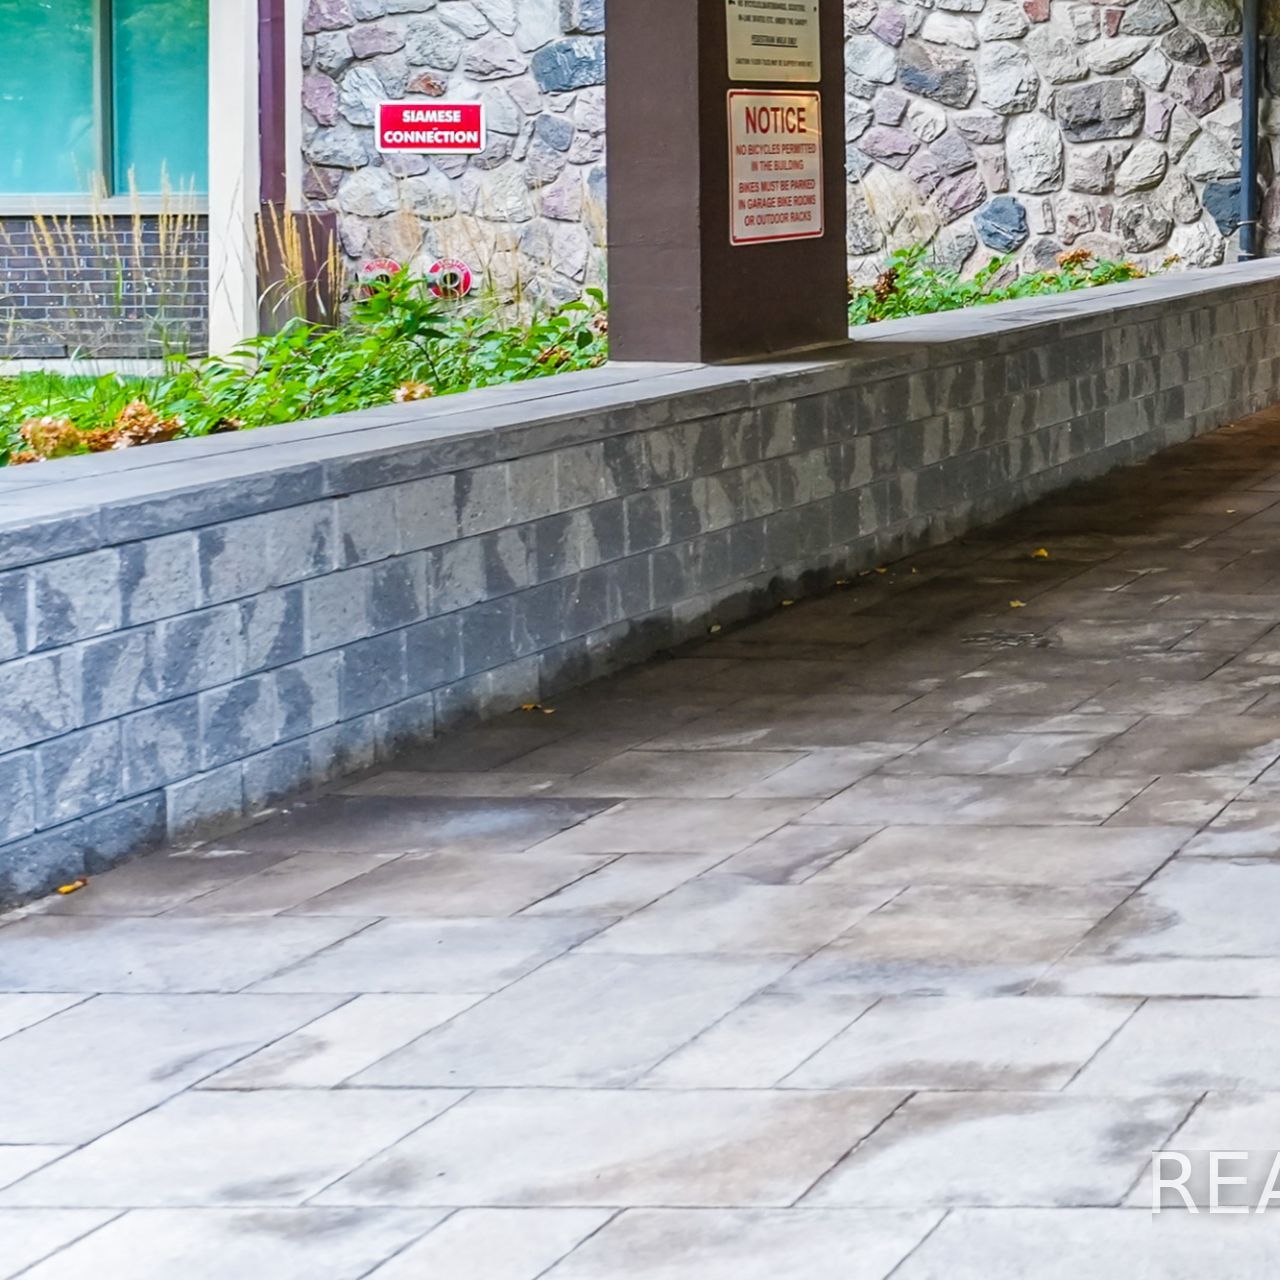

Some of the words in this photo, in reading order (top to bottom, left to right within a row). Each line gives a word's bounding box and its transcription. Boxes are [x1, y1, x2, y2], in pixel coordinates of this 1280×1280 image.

[402, 110, 461, 122] SIAMESE
[745, 106, 806, 134] NOTICE
[384, 130, 478, 143] CONNECTION
[736, 145, 746, 155] NO
[748, 144, 780, 155] BICYCLES
[782, 143, 816, 154] PERMITTED
[760, 161, 772, 171] THE
[774, 160, 804, 170] BUILDING
[739, 182, 759, 193] BIKES
[761, 181, 778, 192] MUST
[780, 180, 789, 191] BE
[791, 179, 815, 190] PARKED
[738, 200, 745, 210] IN
[748, 198, 776, 209] GARAGE
[778, 196, 792, 207] BIKE
[794, 195, 816, 206] ROOMS
[744, 215, 754, 226] OR
[757, 213, 788, 225] OUTDOOR
[791, 211, 811, 222] RACKS
